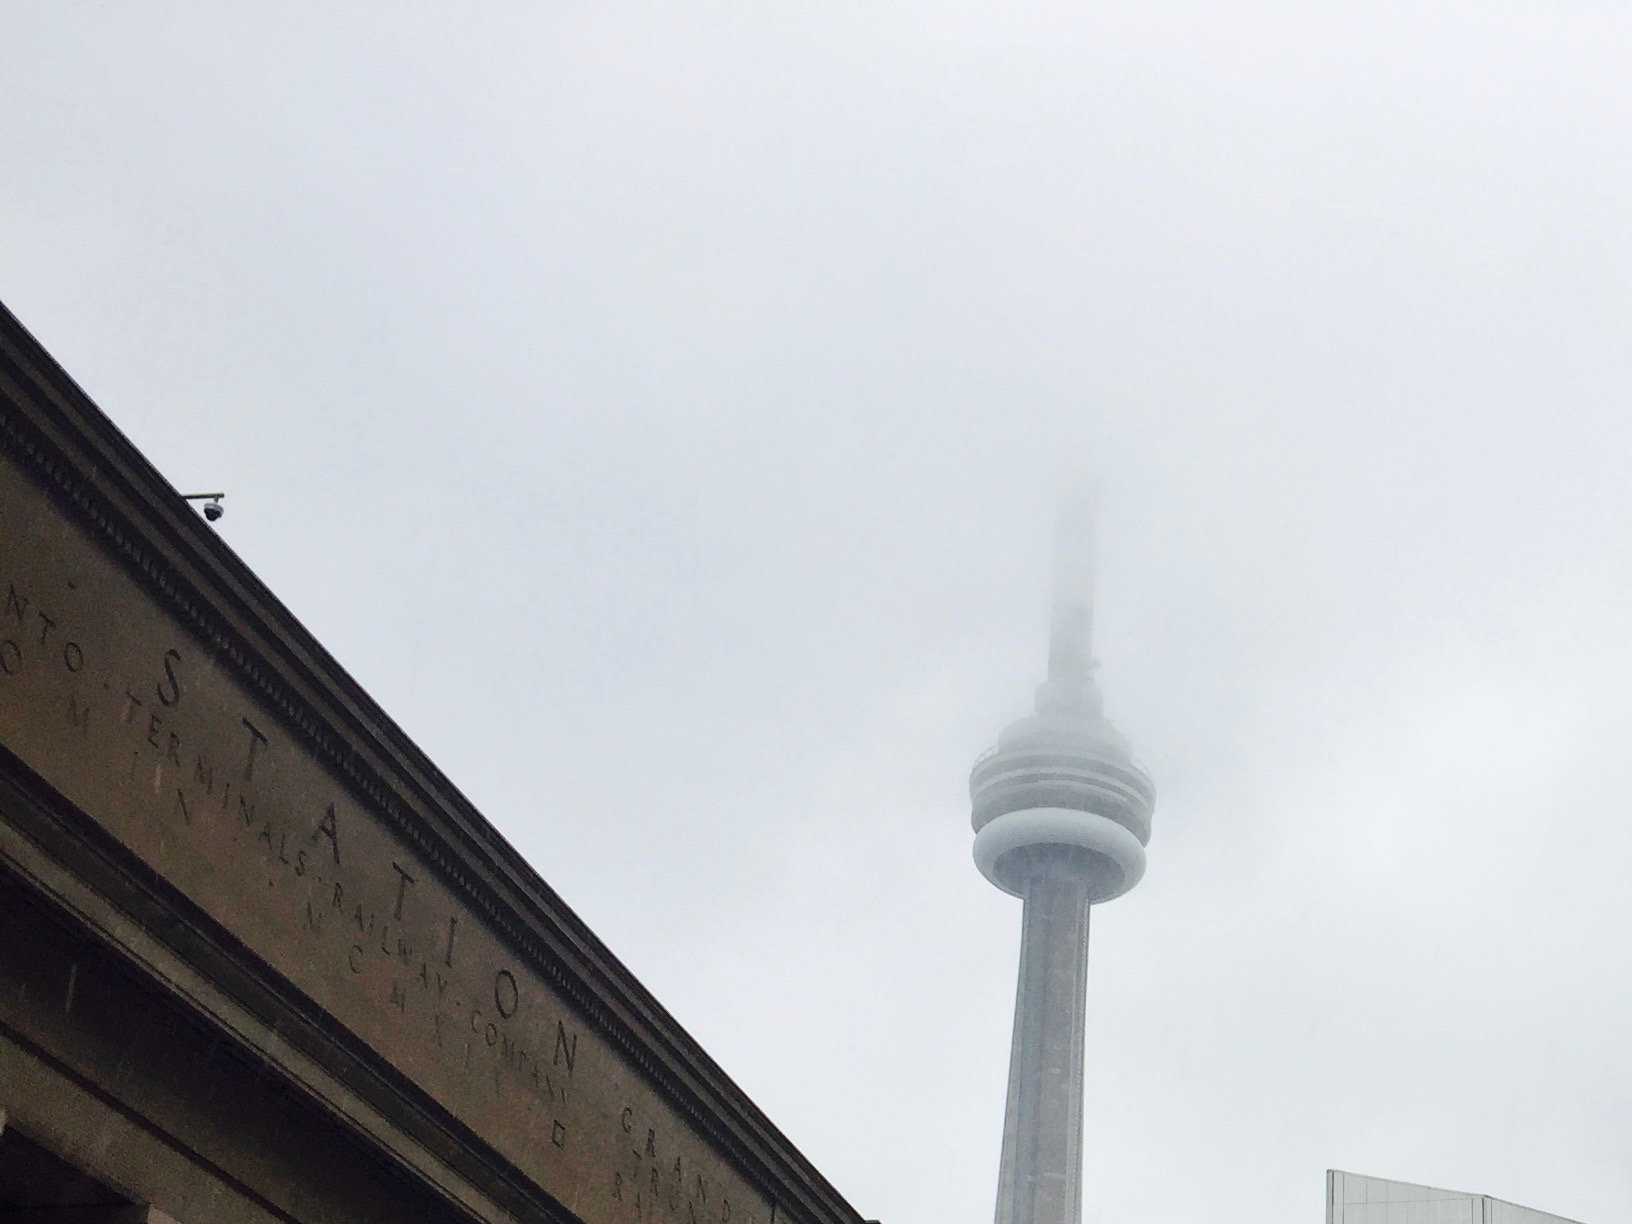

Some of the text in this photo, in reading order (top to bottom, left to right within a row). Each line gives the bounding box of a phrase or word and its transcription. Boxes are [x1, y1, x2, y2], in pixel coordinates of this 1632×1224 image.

[125, 688, 307, 877] TERMINALS
[332, 882, 448, 998] RAILWAY
[157, 649, 578, 1076] STATION
[621, 1107, 731, 1223] GRAND
